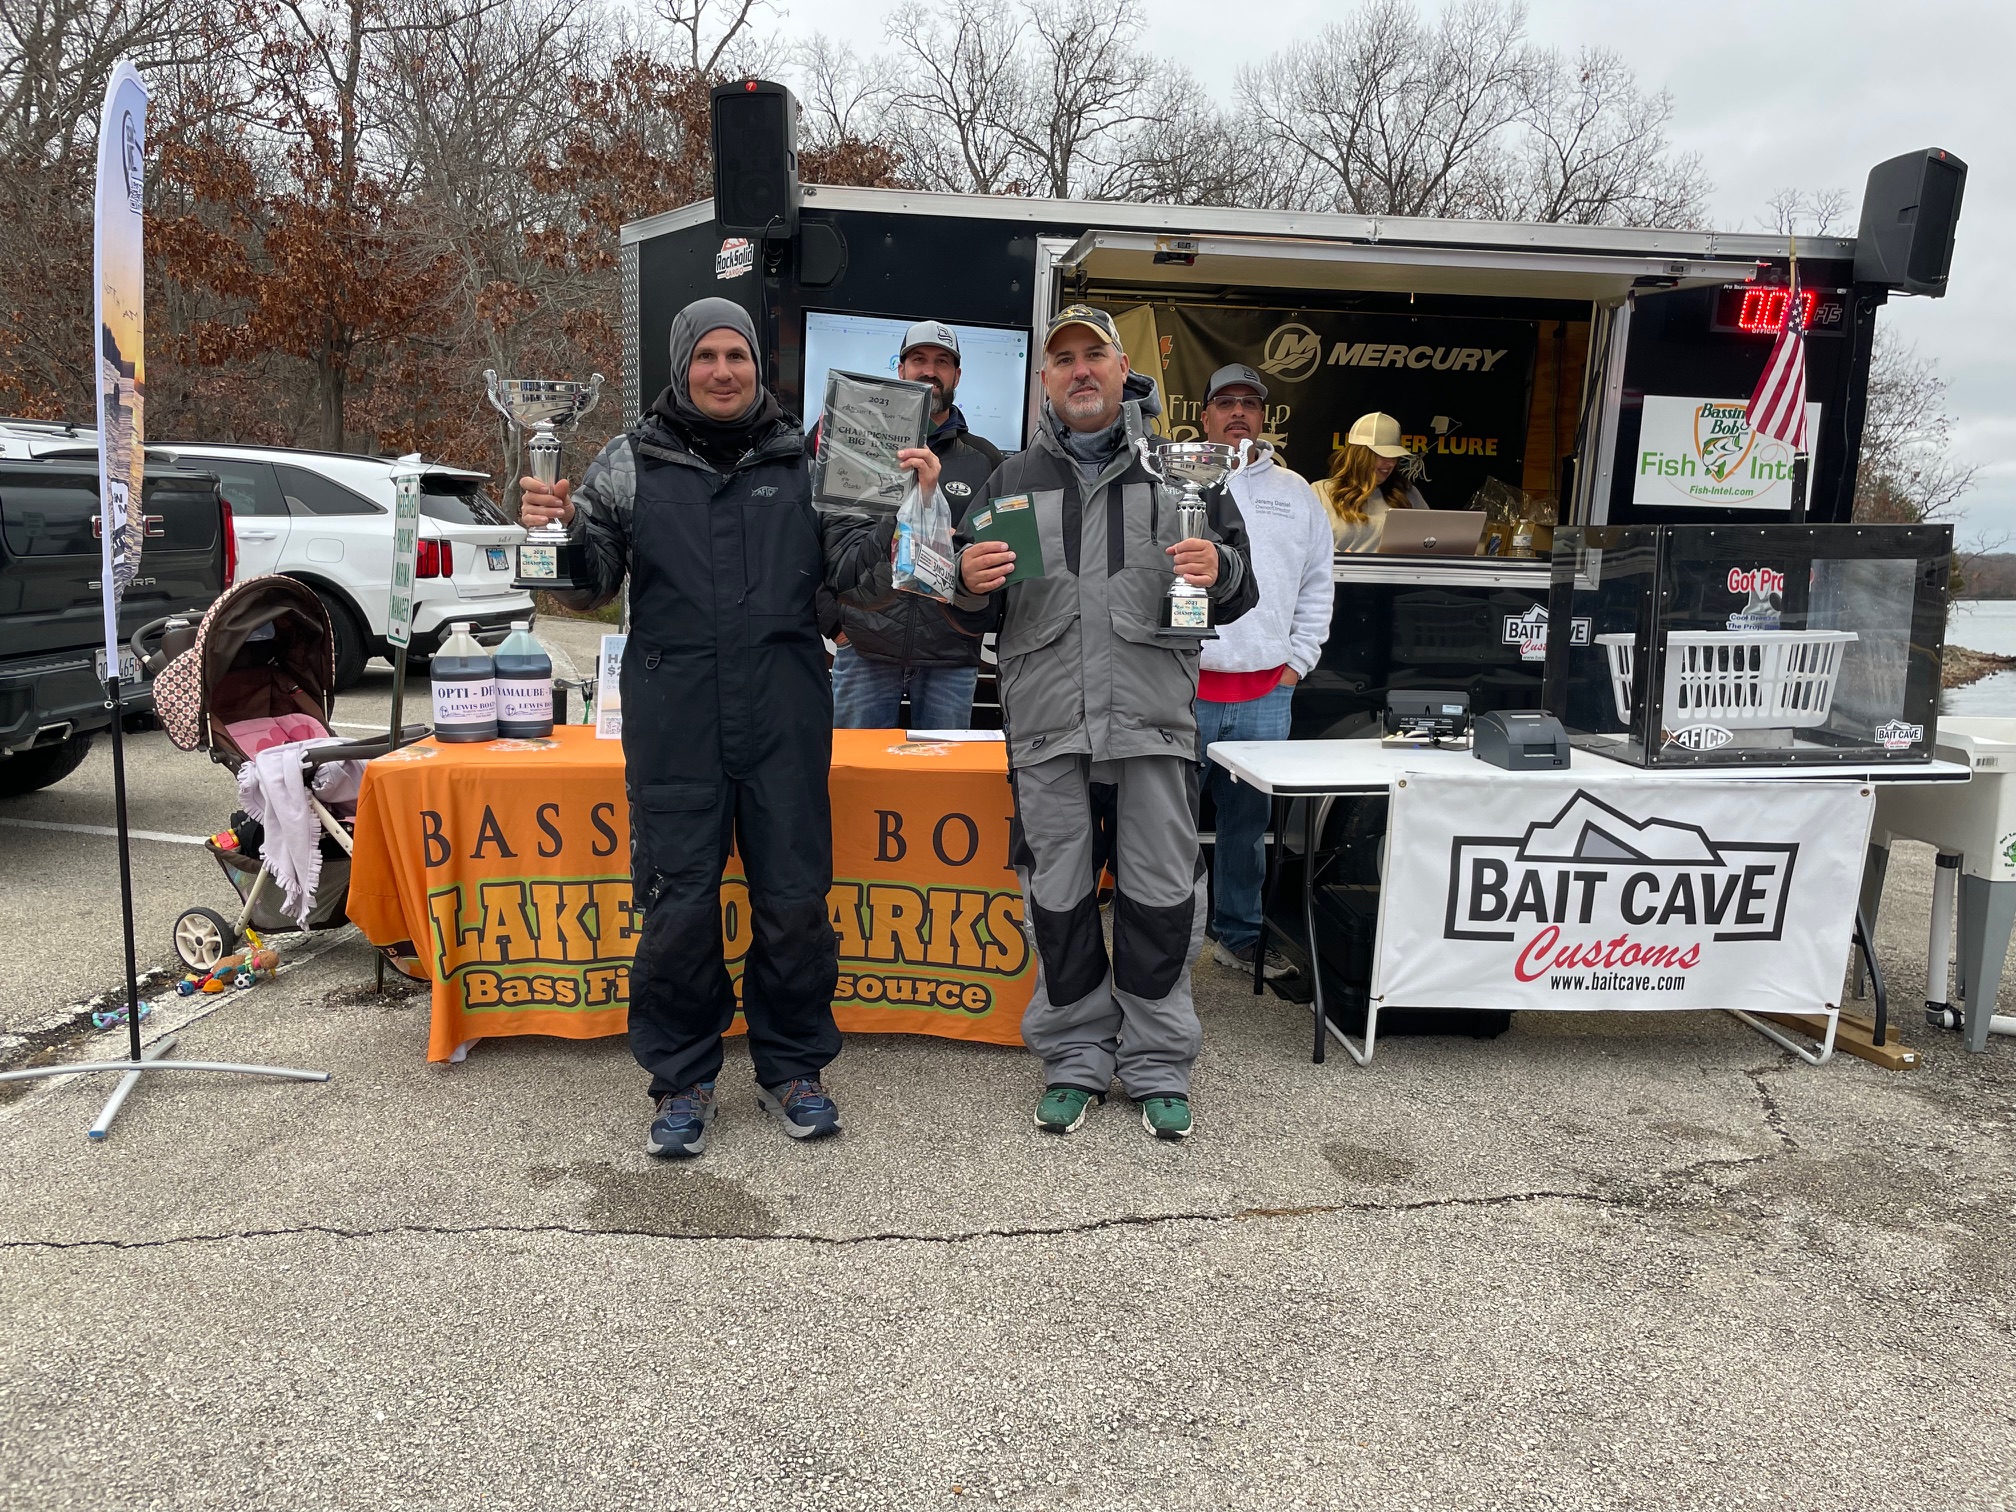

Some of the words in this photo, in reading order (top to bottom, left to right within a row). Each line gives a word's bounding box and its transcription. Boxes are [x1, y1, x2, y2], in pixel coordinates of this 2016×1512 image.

[1813, 303, 1842, 325] PTS
[1326, 342, 1508, 372] MERCURY
[868, 396, 890, 407] 2023
[1710, 419, 1739, 436] Bob
[848, 436, 866, 446] BIG
[1437, 436, 1498, 456] LURE
[1640, 451, 1696, 477] Fish
[1689, 485, 1754, 496] Fish-Intel.com
[1728, 568, 1756, 592] Got
[1508, 621, 1543, 639] BAIT
[438, 687, 469, 699] OPTI
[497, 687, 545, 697] YAMALUBE
[451, 703, 478, 711] LEWIS
[1878, 729, 1897, 739] BAIT
[1898, 729, 1920, 739] CAVE
[1468, 857, 1608, 924] BAIT
[1619, 864, 1776, 926] CAVE
[429, 881, 643, 979] LAKE
[1513, 924, 1701, 983] Customs
[464, 973, 576, 1006] Bass
[1549, 971, 1686, 992] www.baitcave.com
